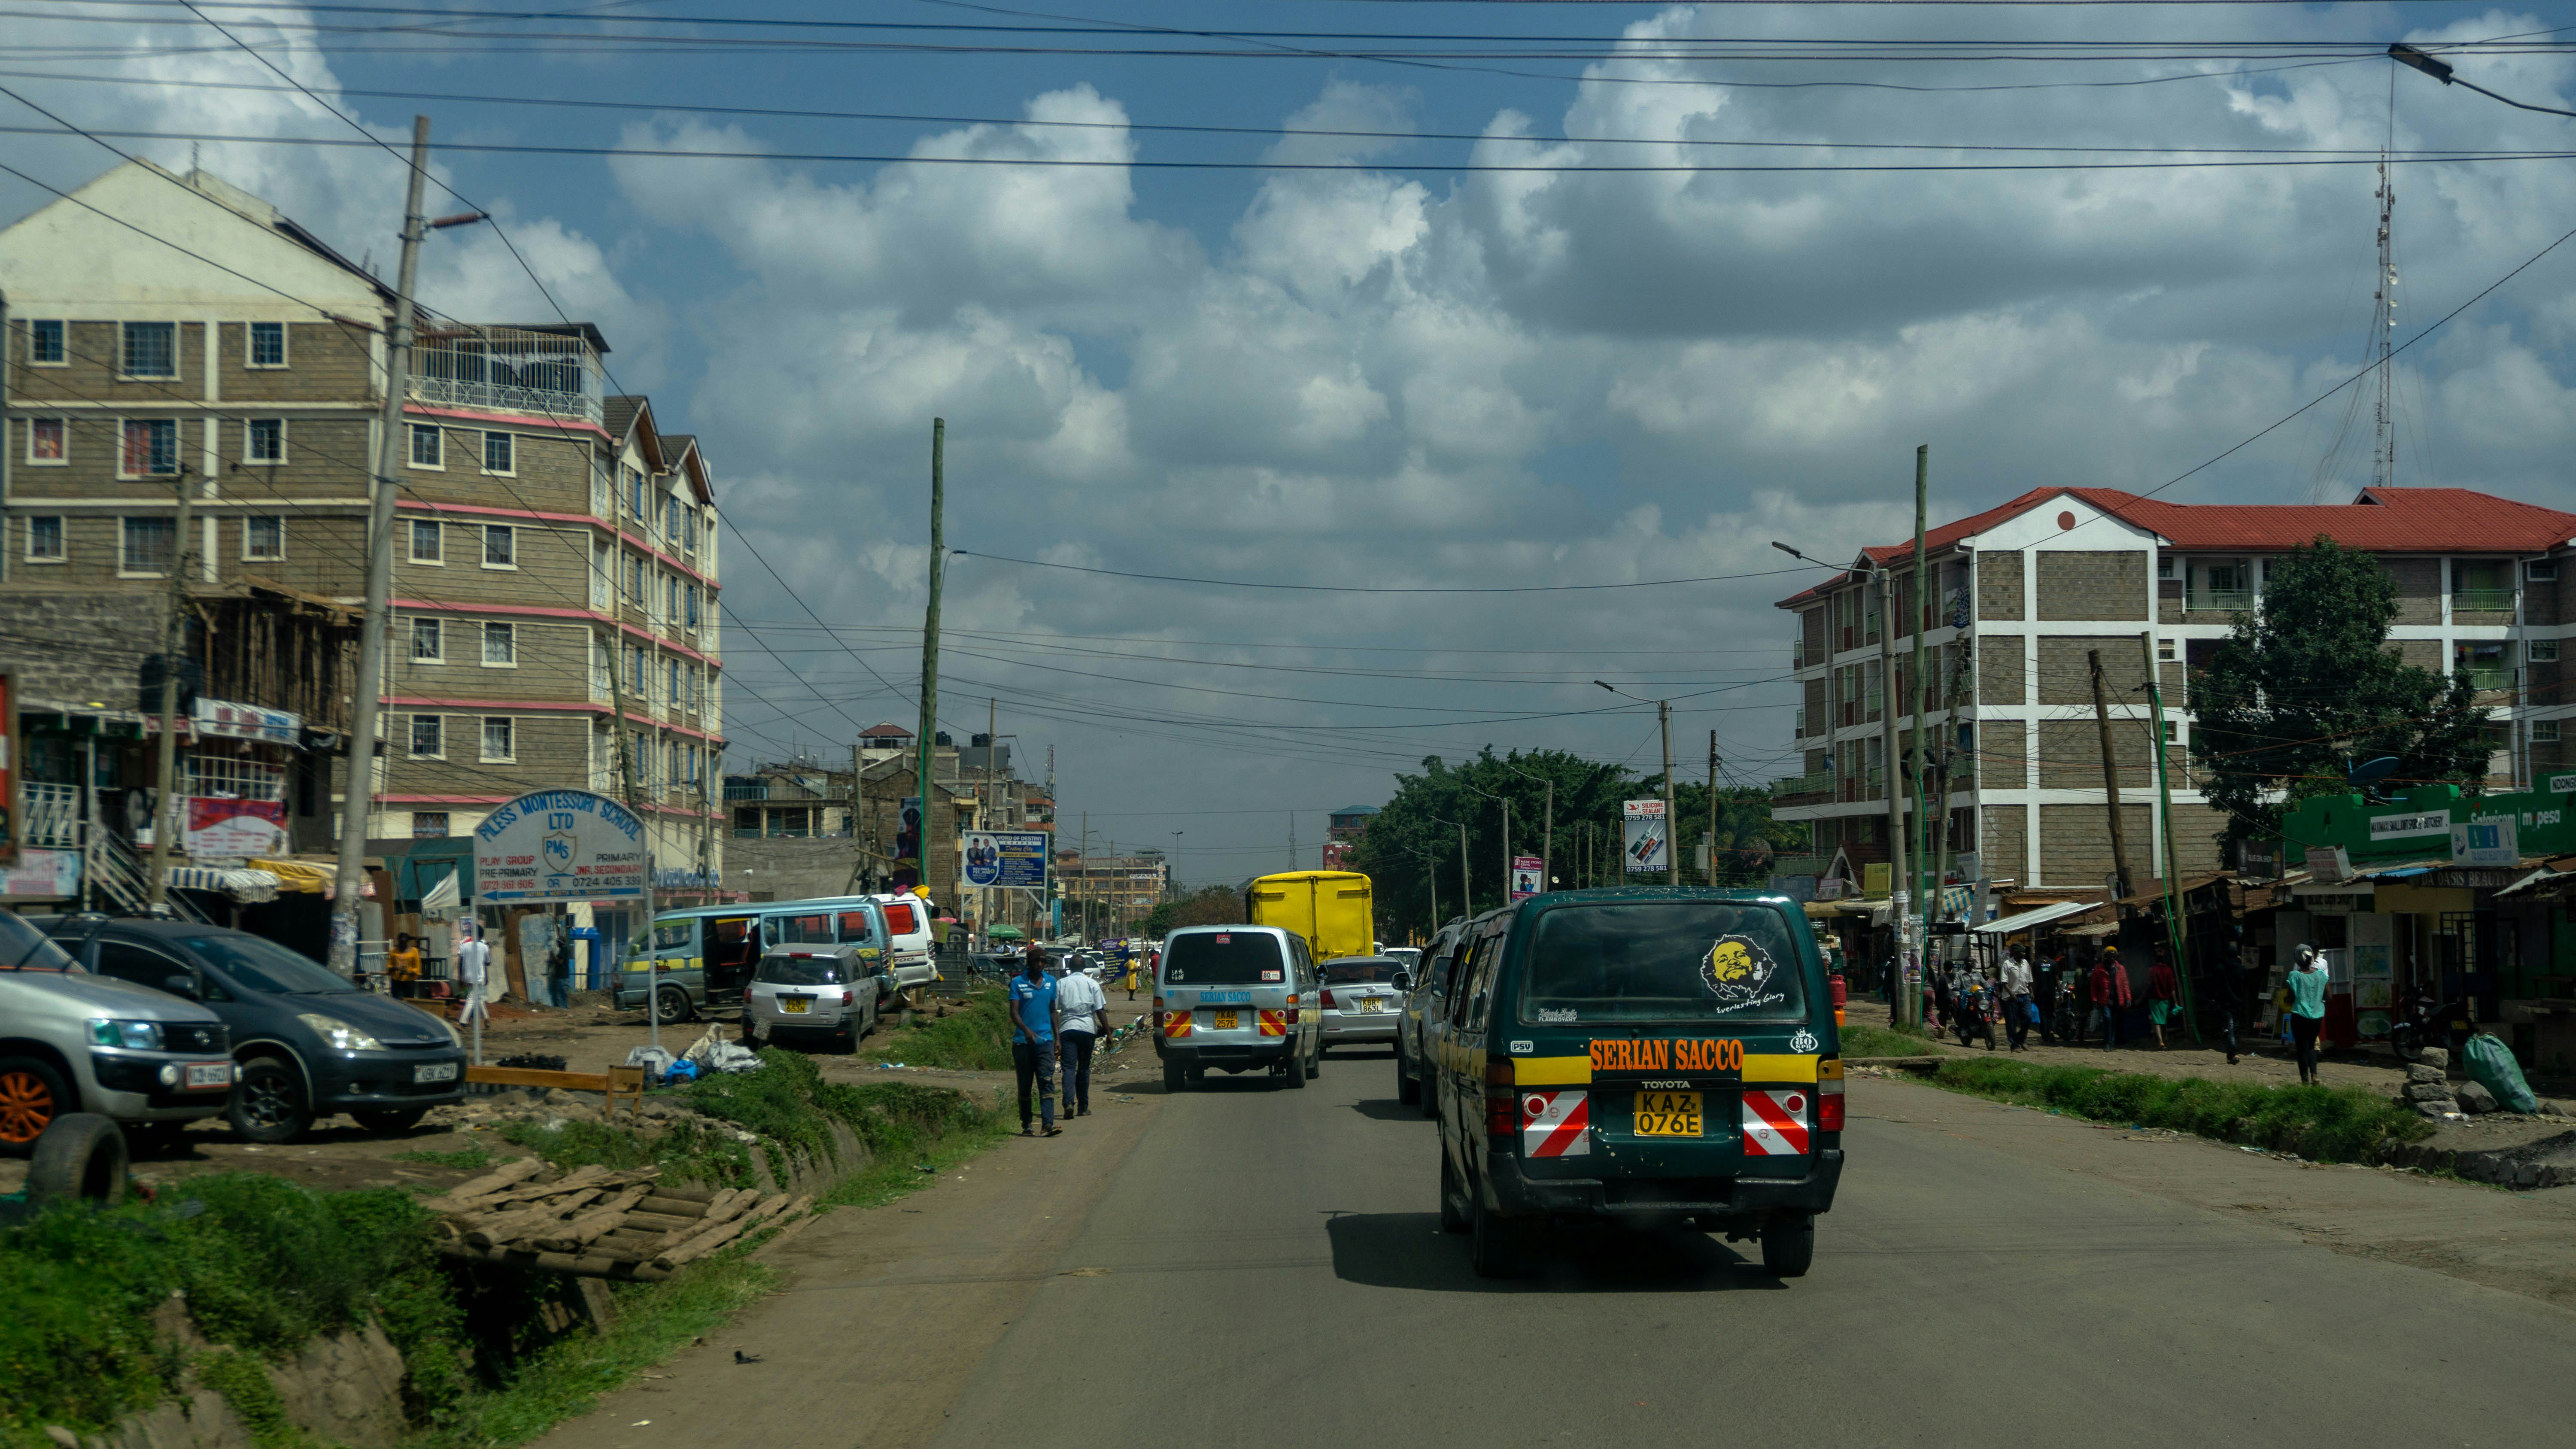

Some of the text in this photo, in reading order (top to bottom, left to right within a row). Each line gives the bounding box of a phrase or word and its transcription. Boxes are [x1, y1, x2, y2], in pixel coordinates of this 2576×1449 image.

[518, 792, 596, 815] MONTESSORI
[600, 802, 642, 841] SCHOOL
[549, 813, 574, 829] LTD
[546, 840, 568, 859] PMS
[480, 855, 535, 866] PLAY GROUP
[596, 853, 641, 863] PRIMARY
[480, 867, 538, 878] PRE-PRIMARY
[594, 864, 642, 875] SECONDARY
[547, 878, 560, 888] OR
[572, 877, 599, 887] 0724
[625, 876, 641, 886] 339
[2439, 871, 2464, 887] OASIS
[1200, 991, 1251, 1002] SERIAN SACCO
[1716, 992, 1785, 1014] Everlasting Glory
[1221, 1010, 1236, 1019] KAP
[1589, 1039, 1744, 1071] SERIAN SACCO
[1641, 1080, 1691, 1089] TOYOTA
[1643, 1094, 1691, 1112] KAZ
[1639, 1113, 1699, 1133] 076E
